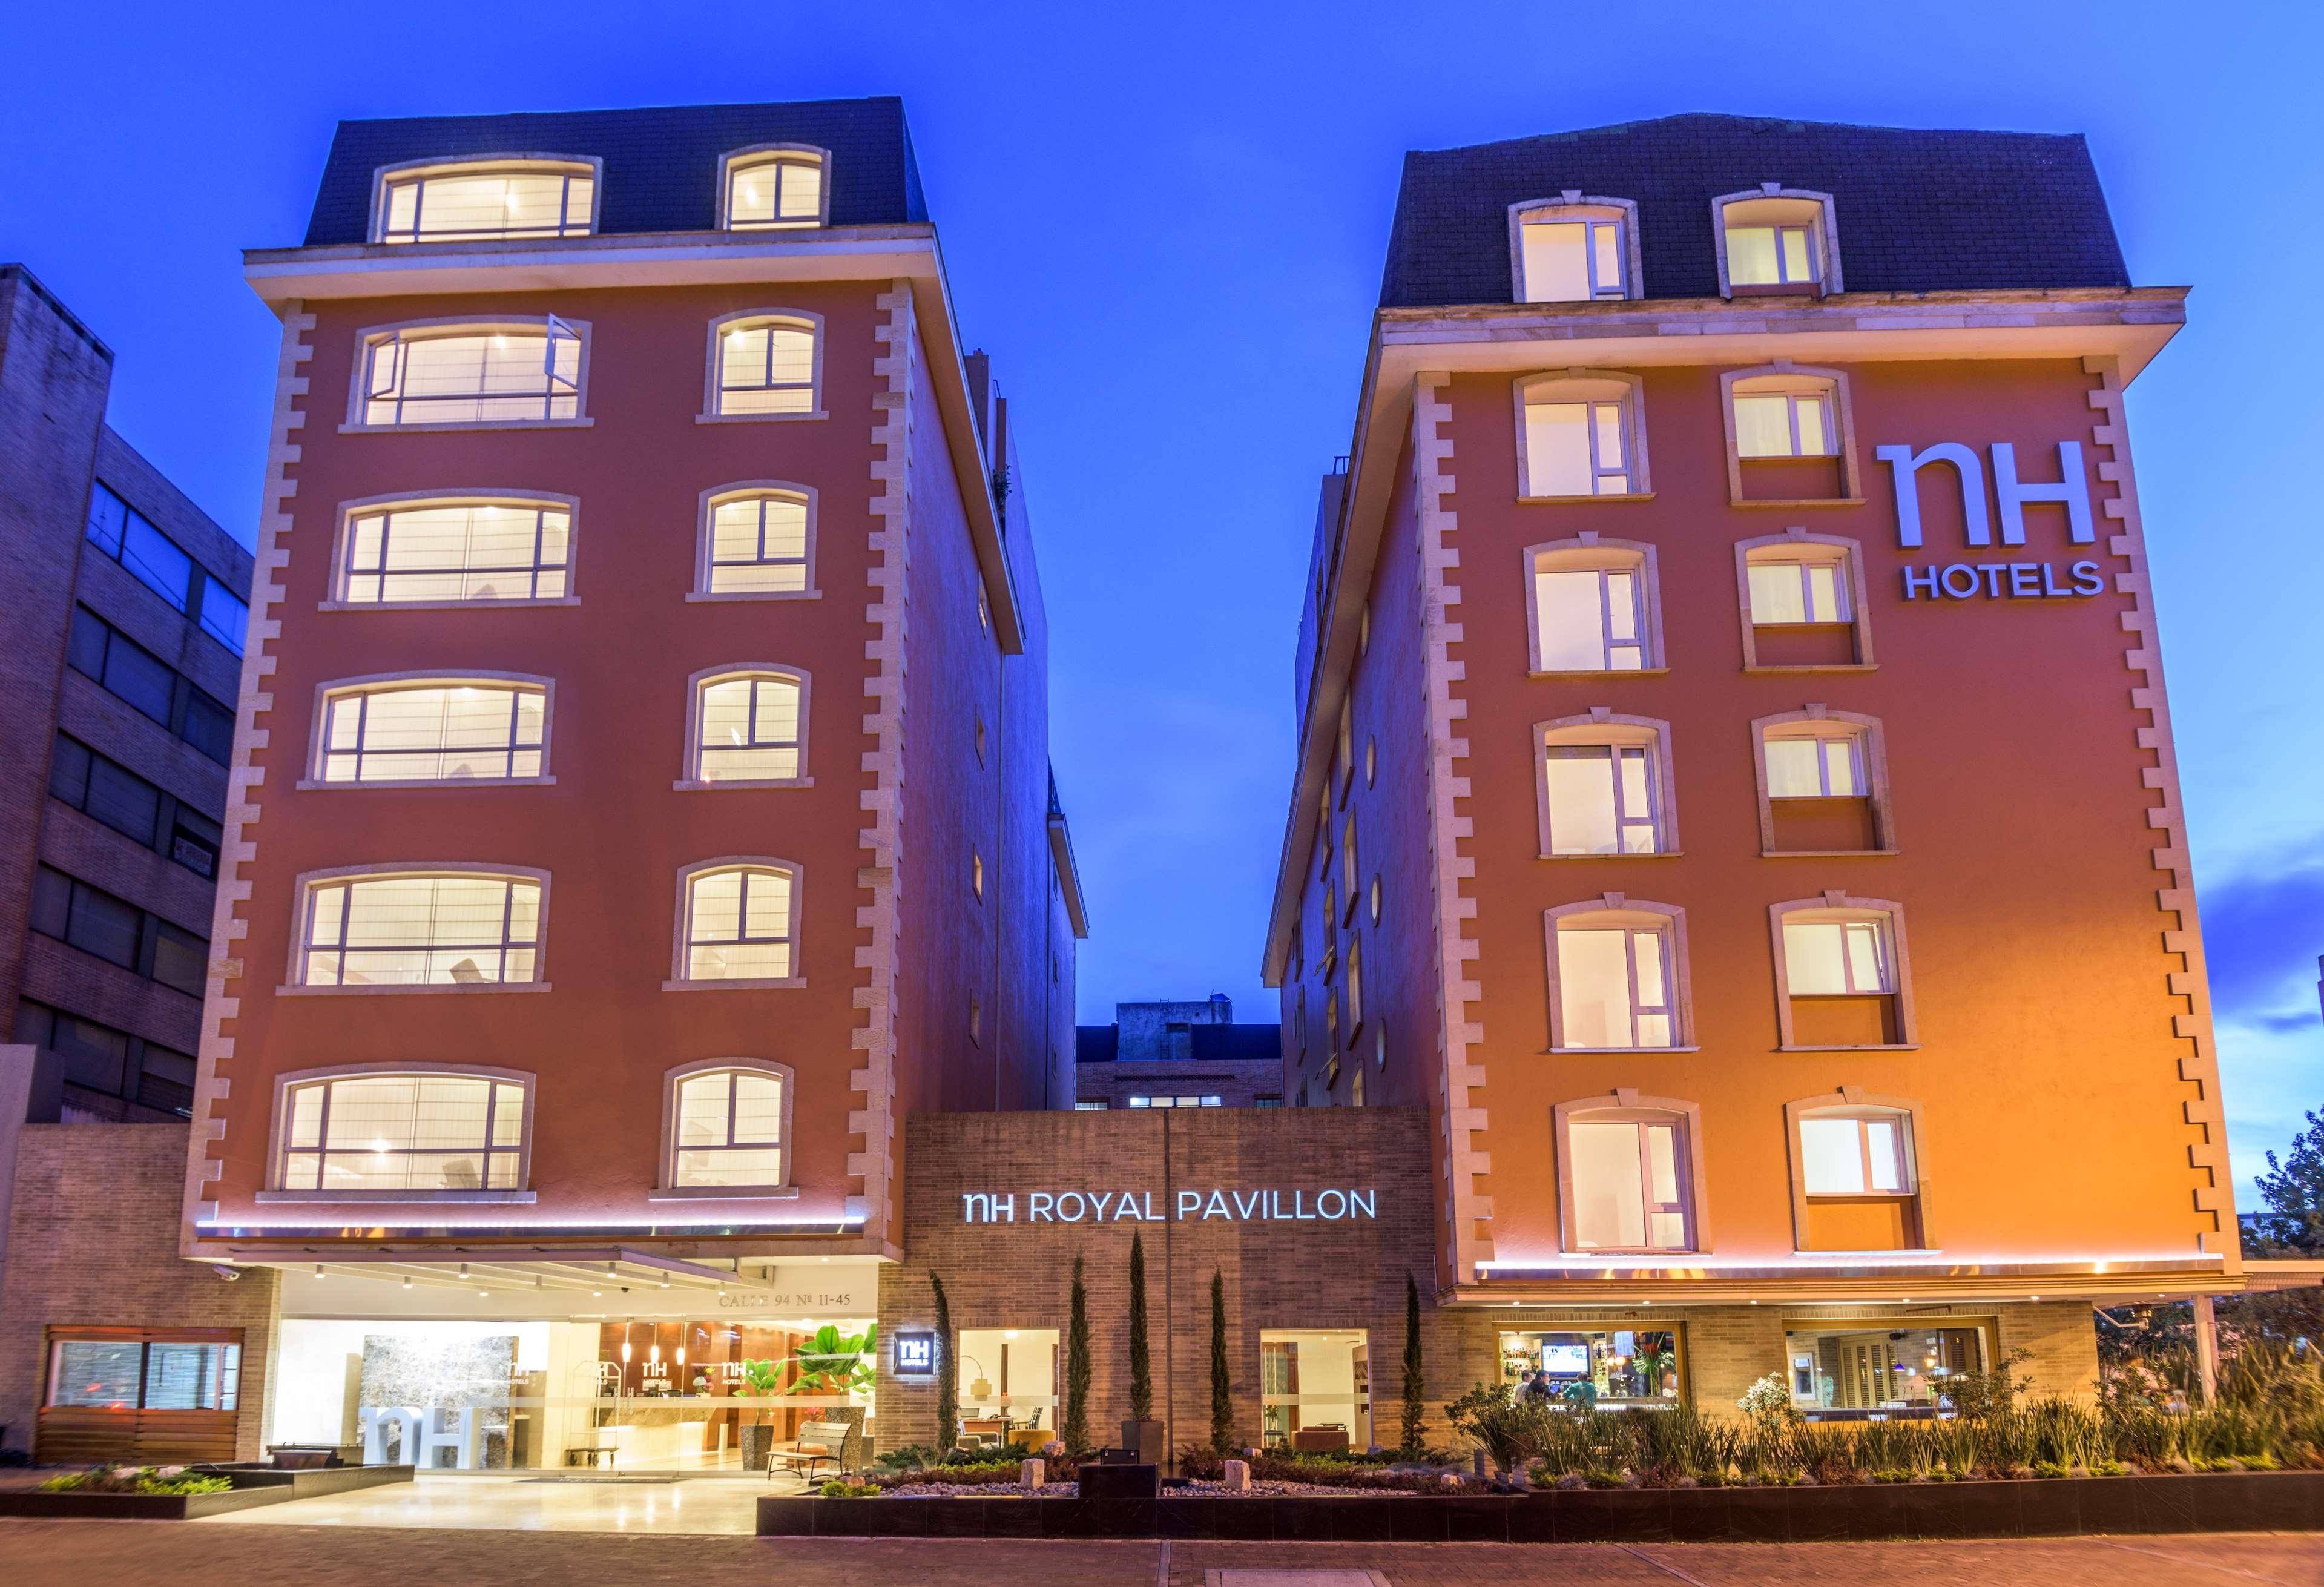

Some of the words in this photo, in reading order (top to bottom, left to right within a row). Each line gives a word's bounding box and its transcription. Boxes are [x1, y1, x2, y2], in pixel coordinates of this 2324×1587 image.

[1902, 561, 2104, 600] HOTELS
[1030, 1192, 1165, 1222] ROYAL
[1178, 1189, 1375, 1220] PAVILLON
[775, 1294, 790, 1305] 94
[819, 1293, 851, 1306] 11-45
